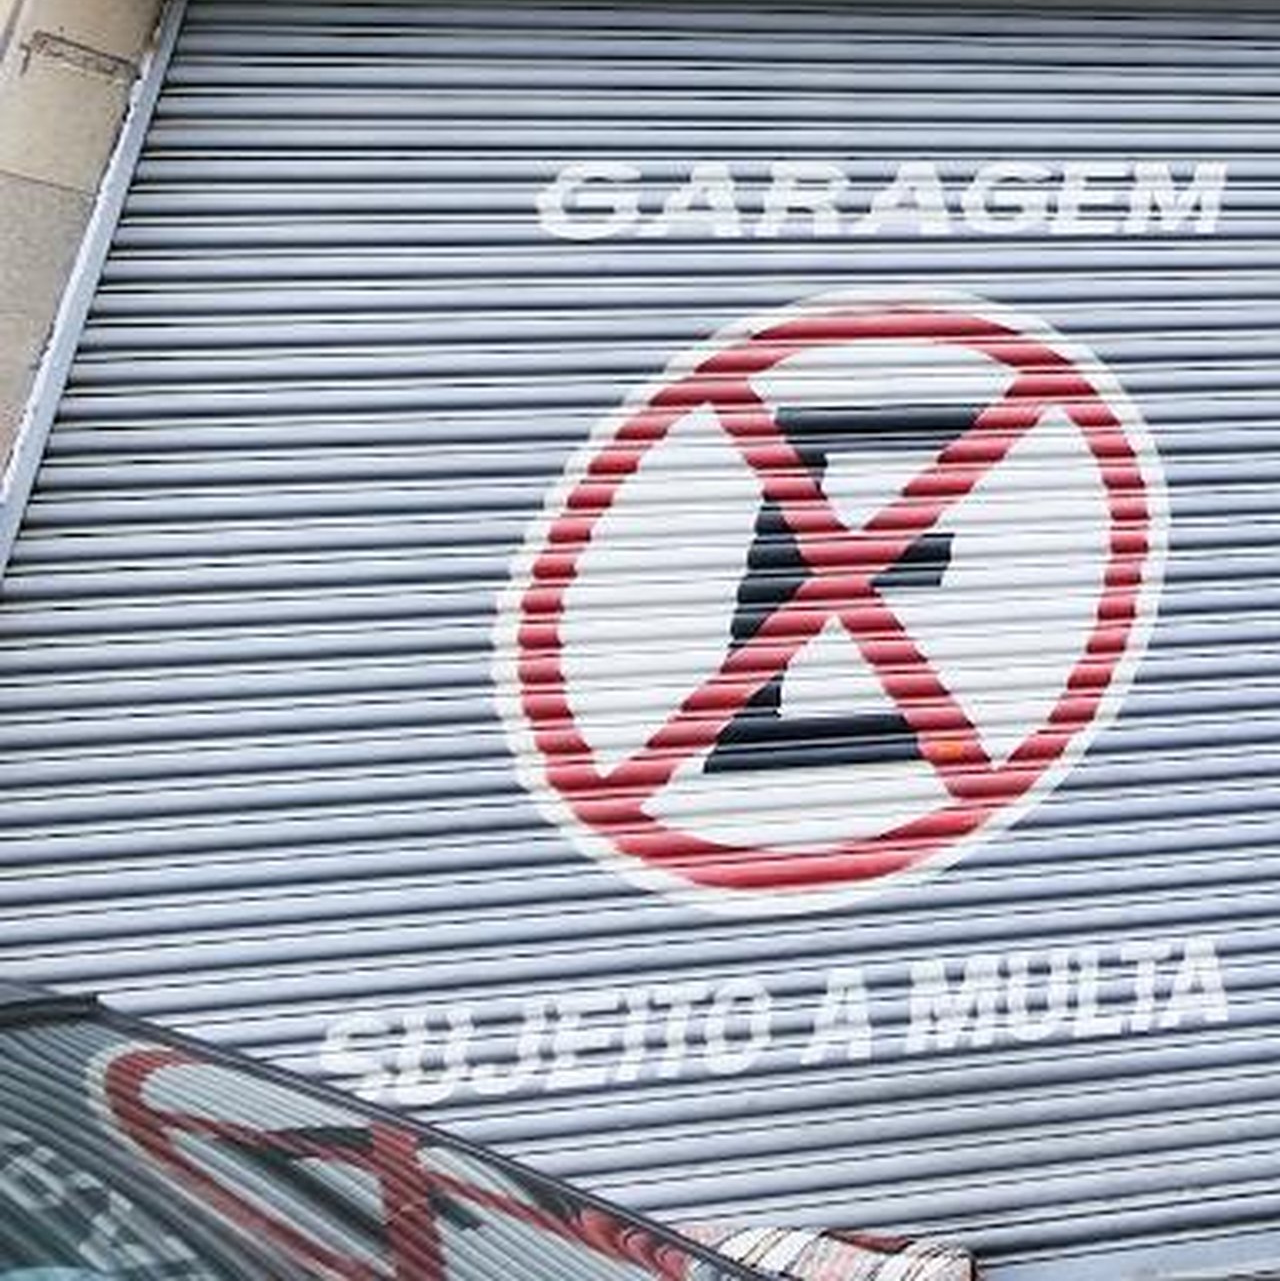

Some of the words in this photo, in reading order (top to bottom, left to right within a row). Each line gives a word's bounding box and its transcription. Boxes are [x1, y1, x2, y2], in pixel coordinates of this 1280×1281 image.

[533, 160, 1228, 241] GARAGEM
[320, 979, 772, 1104] SUJEITO
[801, 966, 872, 1064] A
[906, 939, 1229, 1053] MULTA
